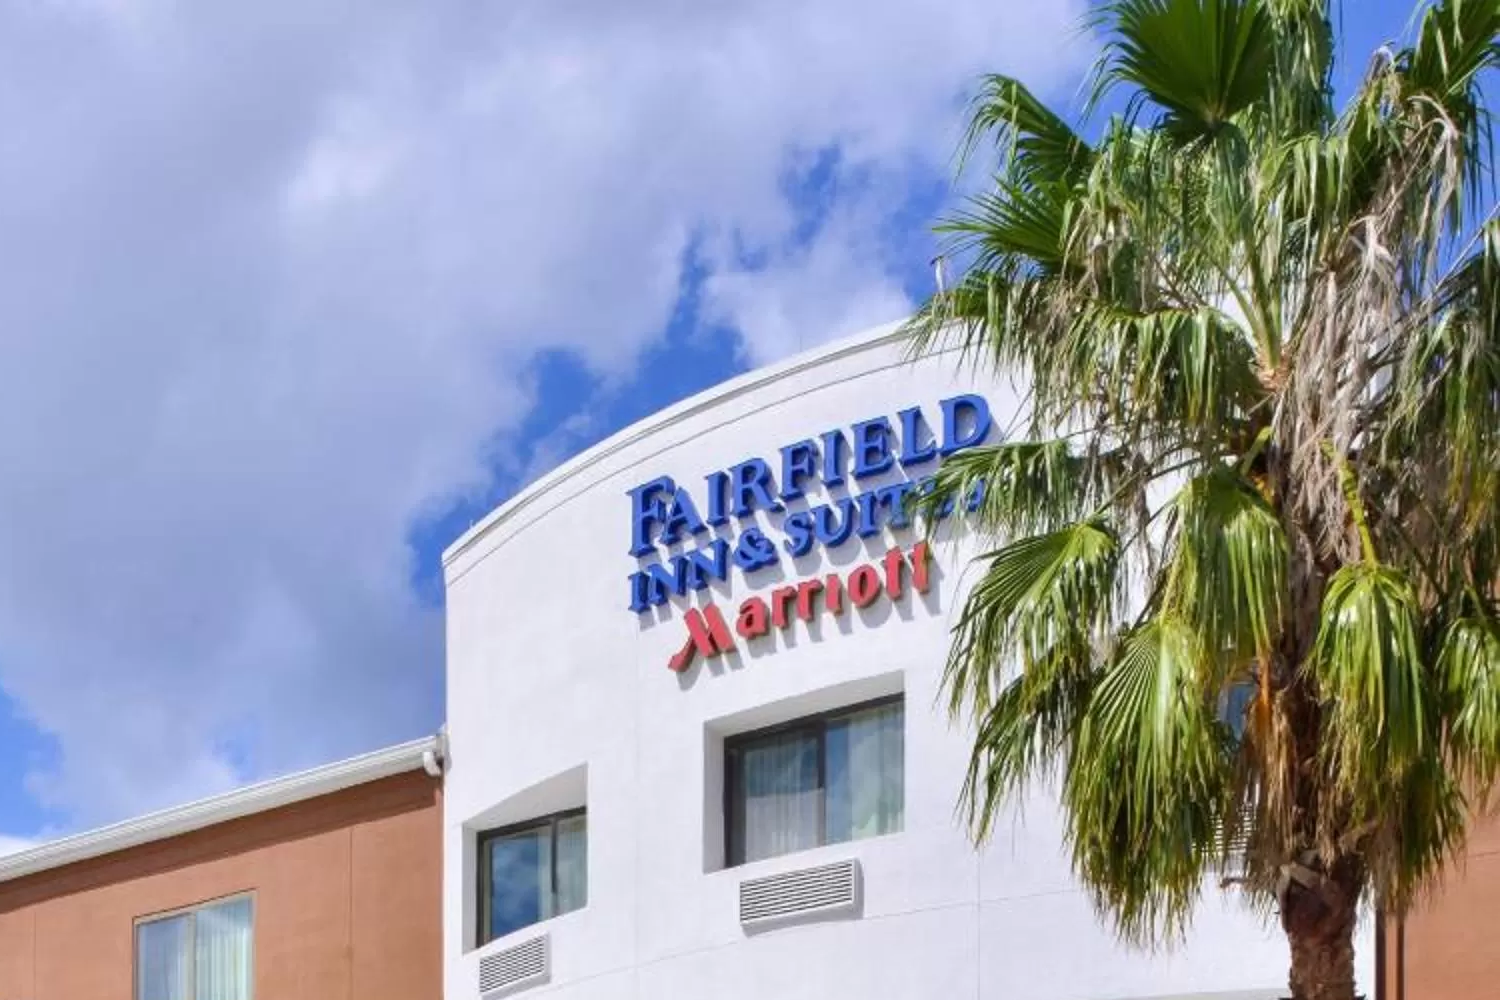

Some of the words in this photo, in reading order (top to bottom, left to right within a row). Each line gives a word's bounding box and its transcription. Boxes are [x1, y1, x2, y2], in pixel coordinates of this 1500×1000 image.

[626, 393, 992, 557] FAIRFIELD
[628, 538, 729, 614] INN
[784, 475, 985, 558] SUIT
[668, 541, 931, 673] Marriott
